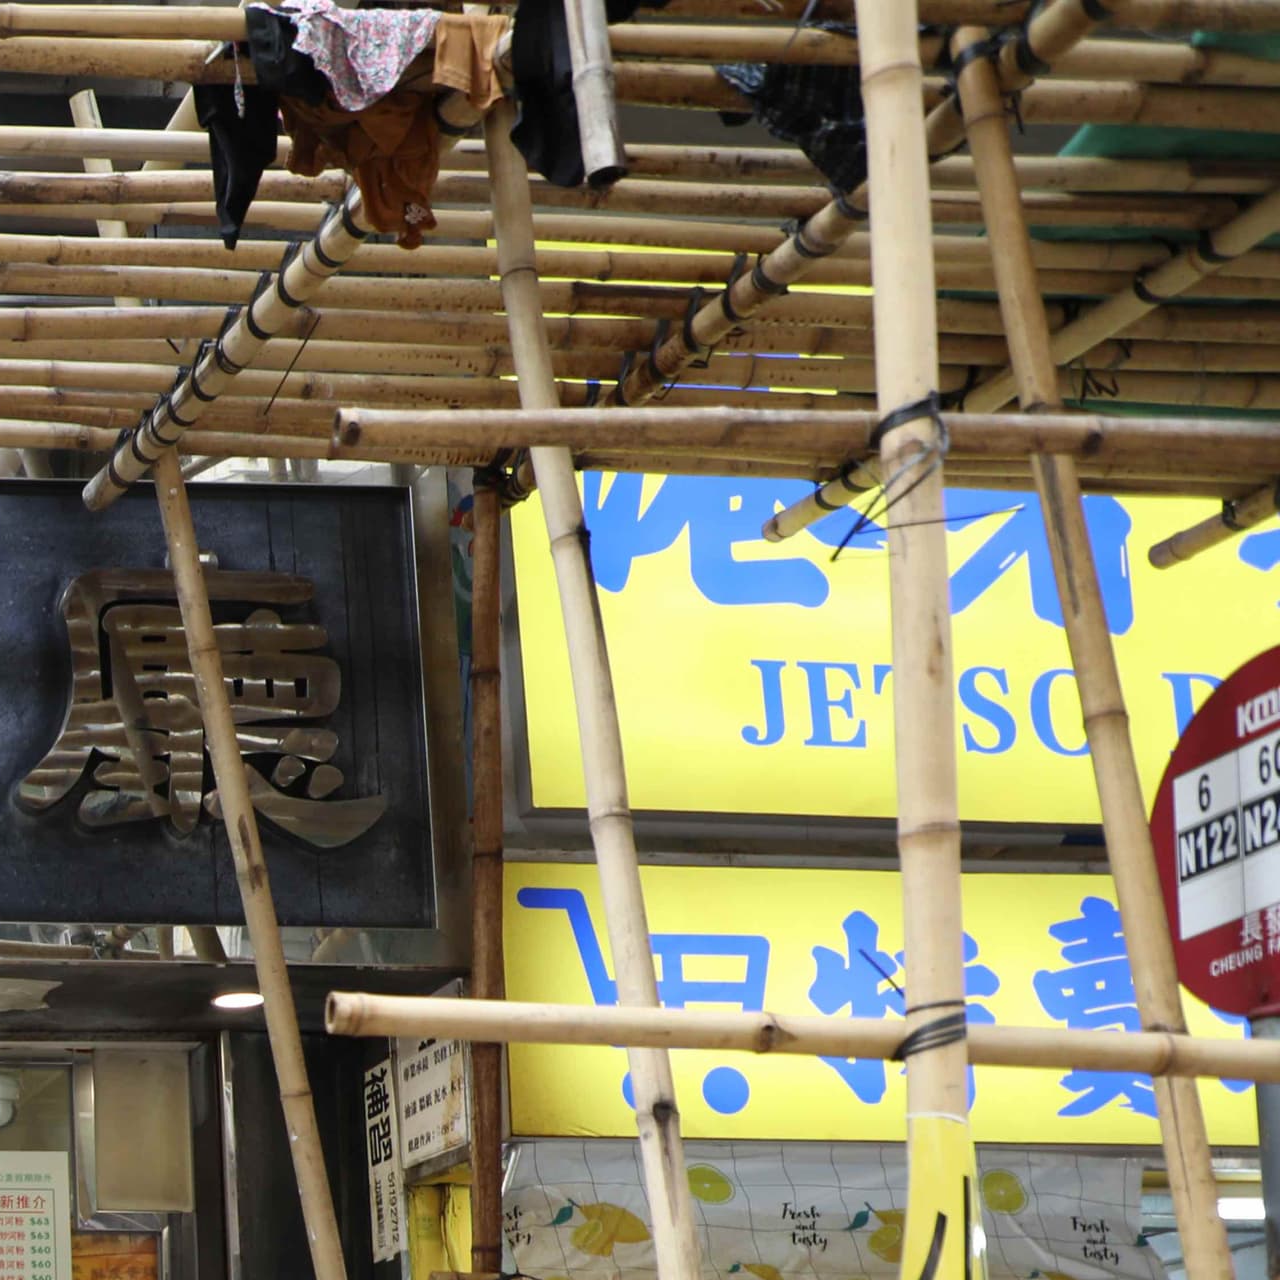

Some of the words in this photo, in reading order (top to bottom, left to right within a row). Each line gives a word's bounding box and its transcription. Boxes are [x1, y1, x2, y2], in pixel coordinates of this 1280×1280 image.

[741, 658, 1094, 756] JESO
[1197, 773, 1212, 813] 6
[1180, 813, 1238, 879] N122
[1210, 945, 1264, 978] CHEUNG
[781, 1202, 821, 1220] Fresh
[1070, 1215, 1112, 1234] Fresh
[790, 1233, 828, 1252] tasty
[1082, 1246, 1121, 1266] tasty
